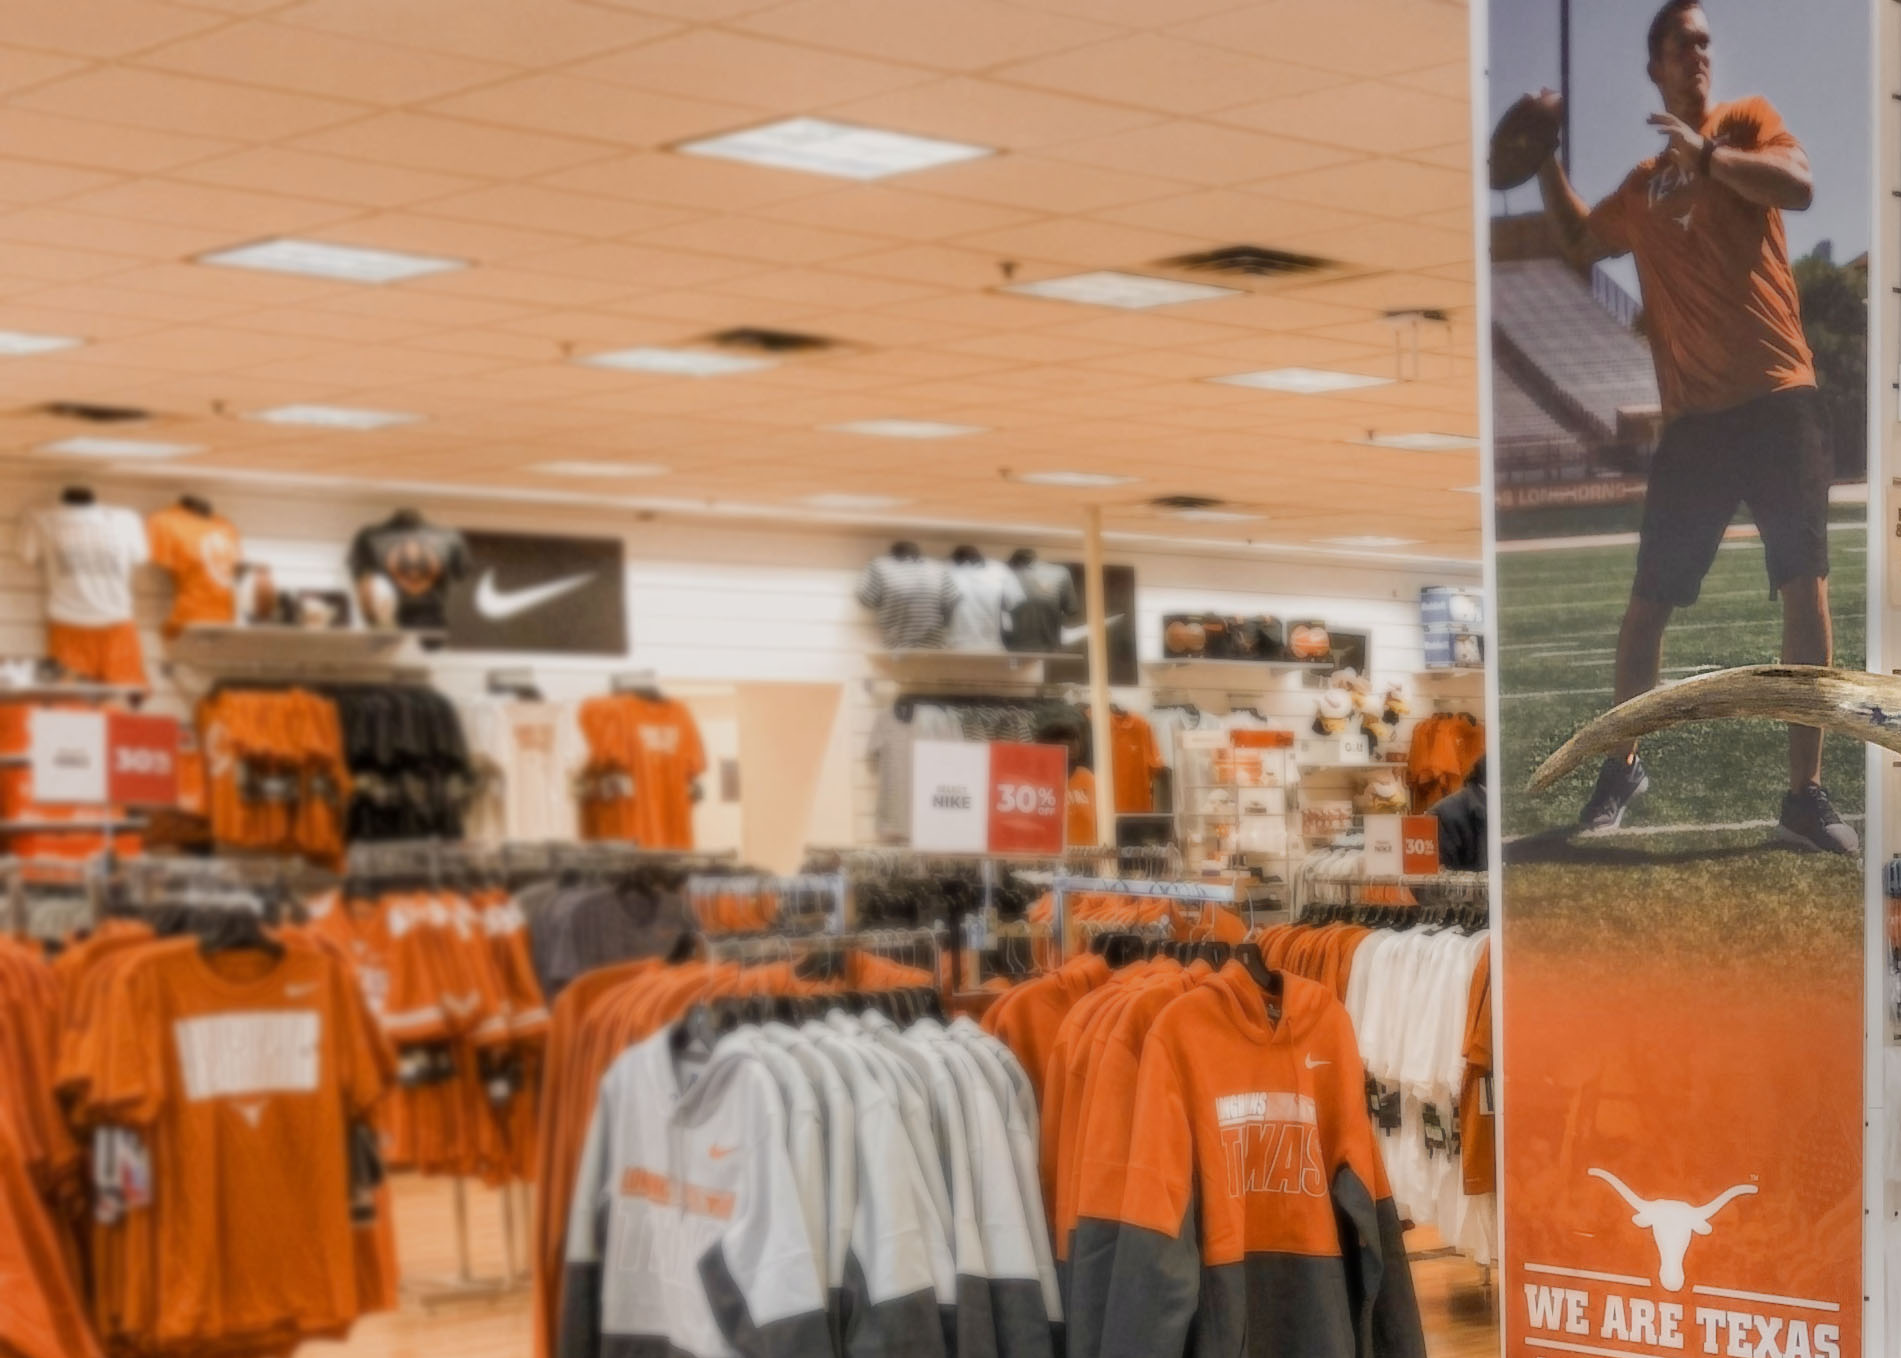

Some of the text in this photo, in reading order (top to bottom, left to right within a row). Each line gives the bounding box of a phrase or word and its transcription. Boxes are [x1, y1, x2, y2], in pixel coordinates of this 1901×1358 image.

[932, 796, 971, 809] NIKE
[1220, 1122, 1329, 1198] TXAS
[1524, 1284, 1589, 1335] WE
[1601, 1295, 1684, 1349] ARE
